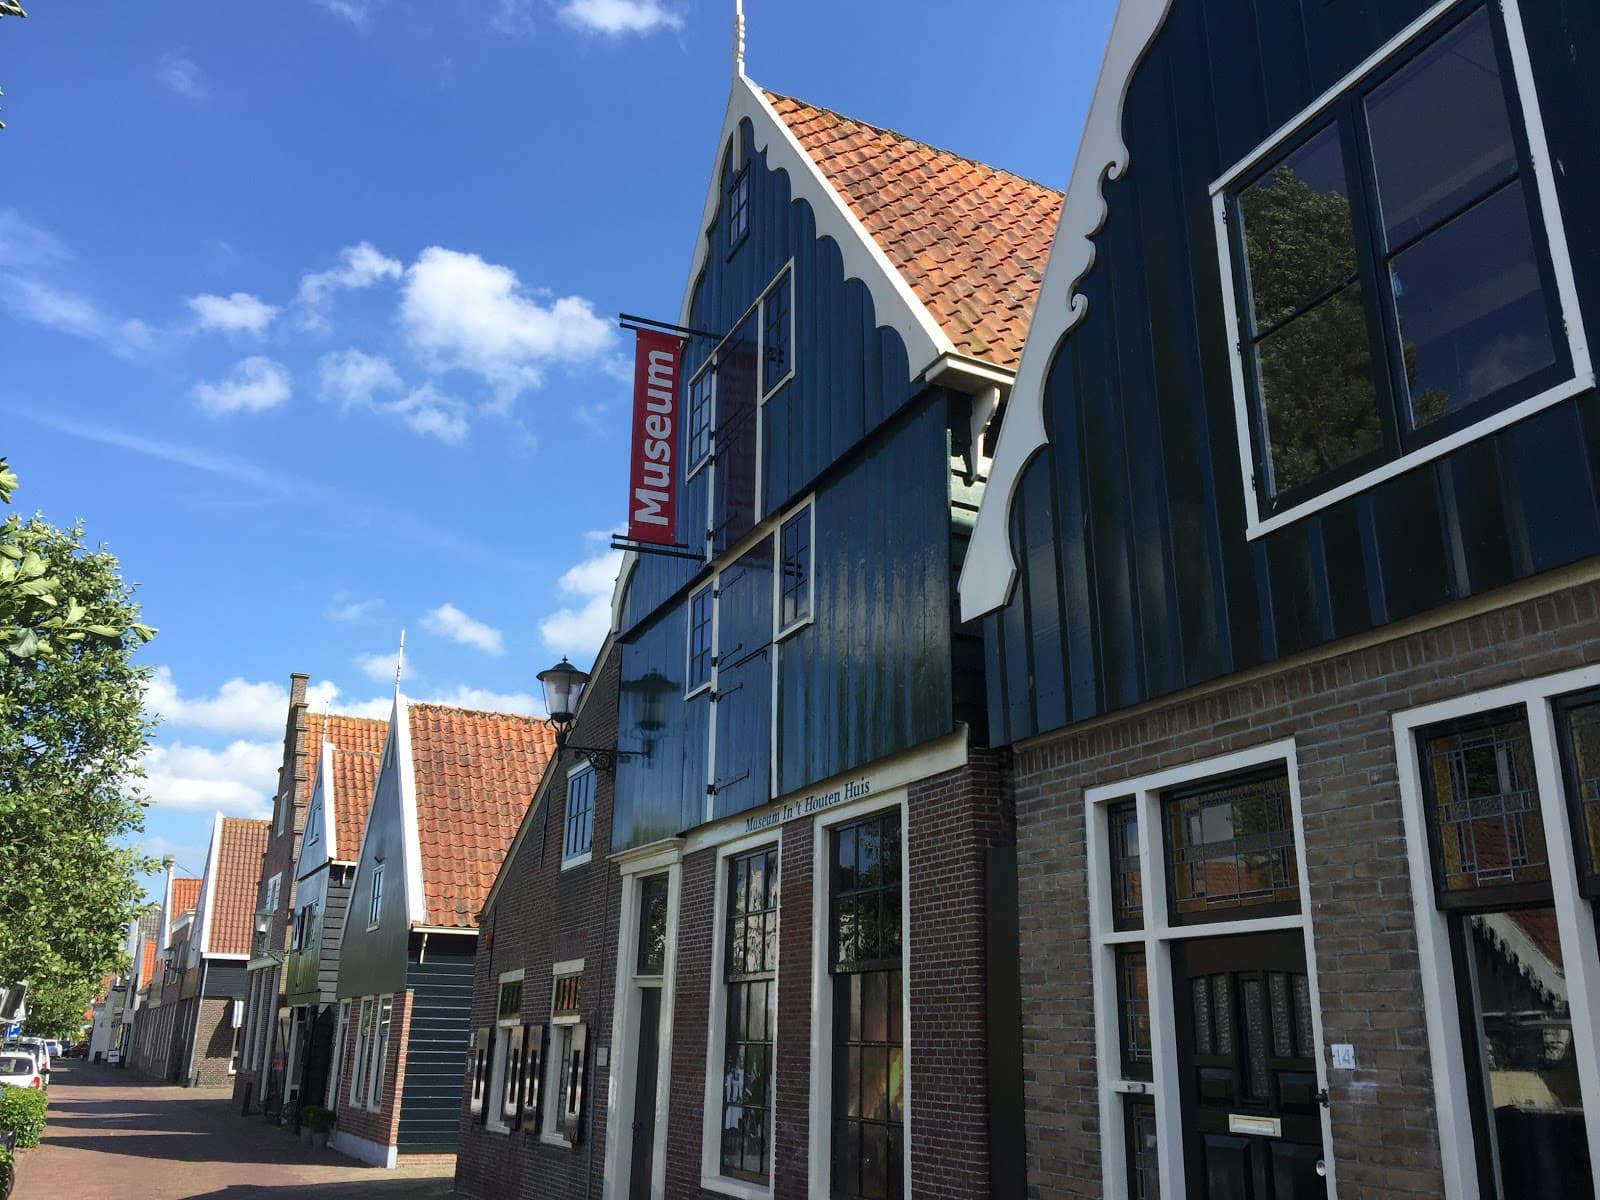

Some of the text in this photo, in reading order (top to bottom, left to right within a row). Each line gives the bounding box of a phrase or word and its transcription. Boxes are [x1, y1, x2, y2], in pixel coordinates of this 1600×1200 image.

[634, 350, 674, 526] Museum
[745, 811, 780, 832] Museum
[782, 805, 793, 821] In
[804, 791, 841, 812] Houten
[844, 777, 870, 800] Huis
[1335, 1048, 1352, 1065] 14
